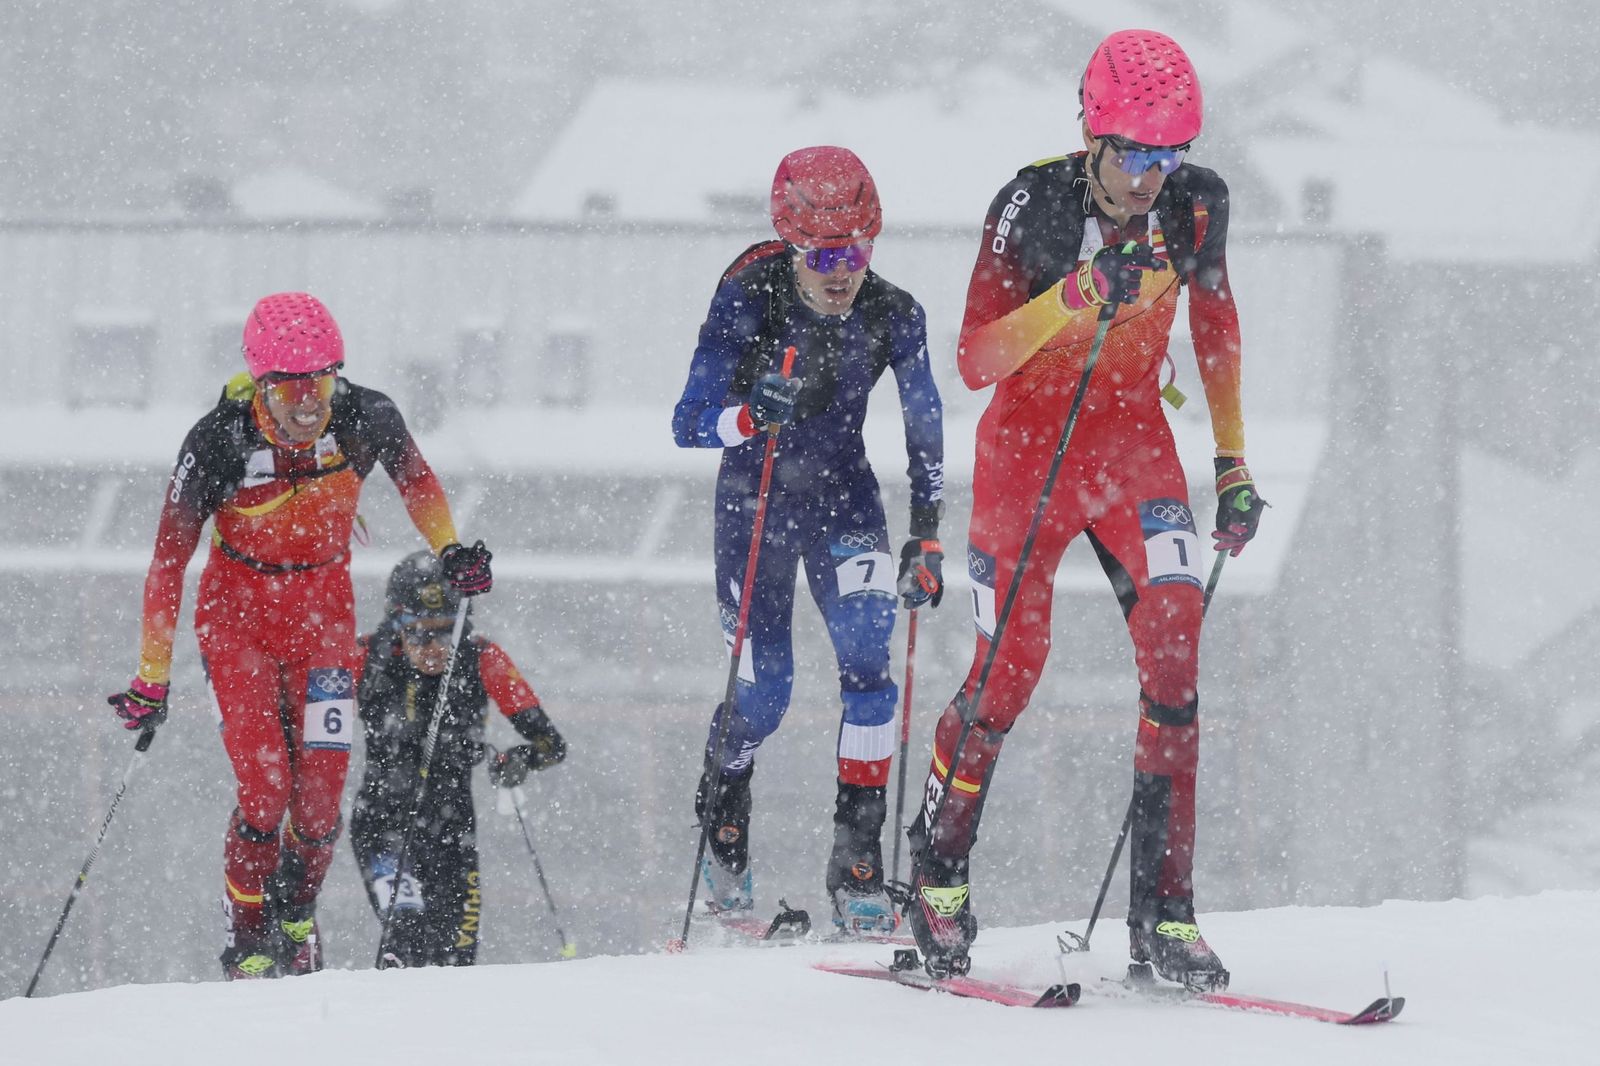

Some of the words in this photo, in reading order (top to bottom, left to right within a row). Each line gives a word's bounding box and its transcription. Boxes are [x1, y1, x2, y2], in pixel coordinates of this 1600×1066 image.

[1172, 538, 1188, 567] 1
[856, 560, 875, 584] 7
[324, 707, 342, 735] 6
[455, 871, 481, 948] CHINA
